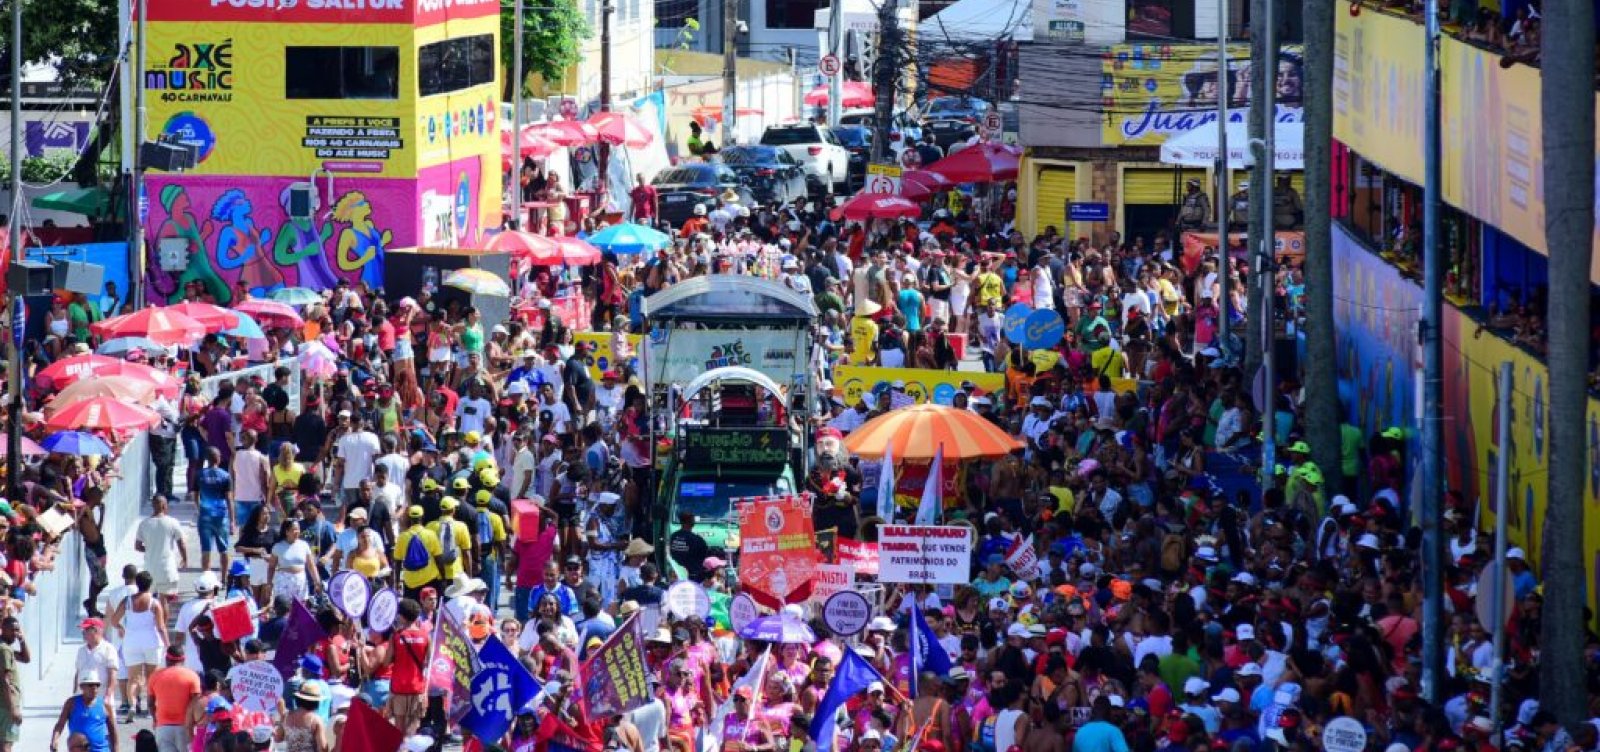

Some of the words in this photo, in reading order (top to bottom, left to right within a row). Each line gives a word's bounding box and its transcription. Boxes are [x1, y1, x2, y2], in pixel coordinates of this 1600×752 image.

[688, 431, 752, 448] FURGÃO
[711, 446, 786, 462] ELÉTRICO
[921, 543, 936, 552] QUE
[940, 544, 967, 553] VENDE
[947, 557, 958, 567] DO
[908, 570, 936, 580] BRASIL
